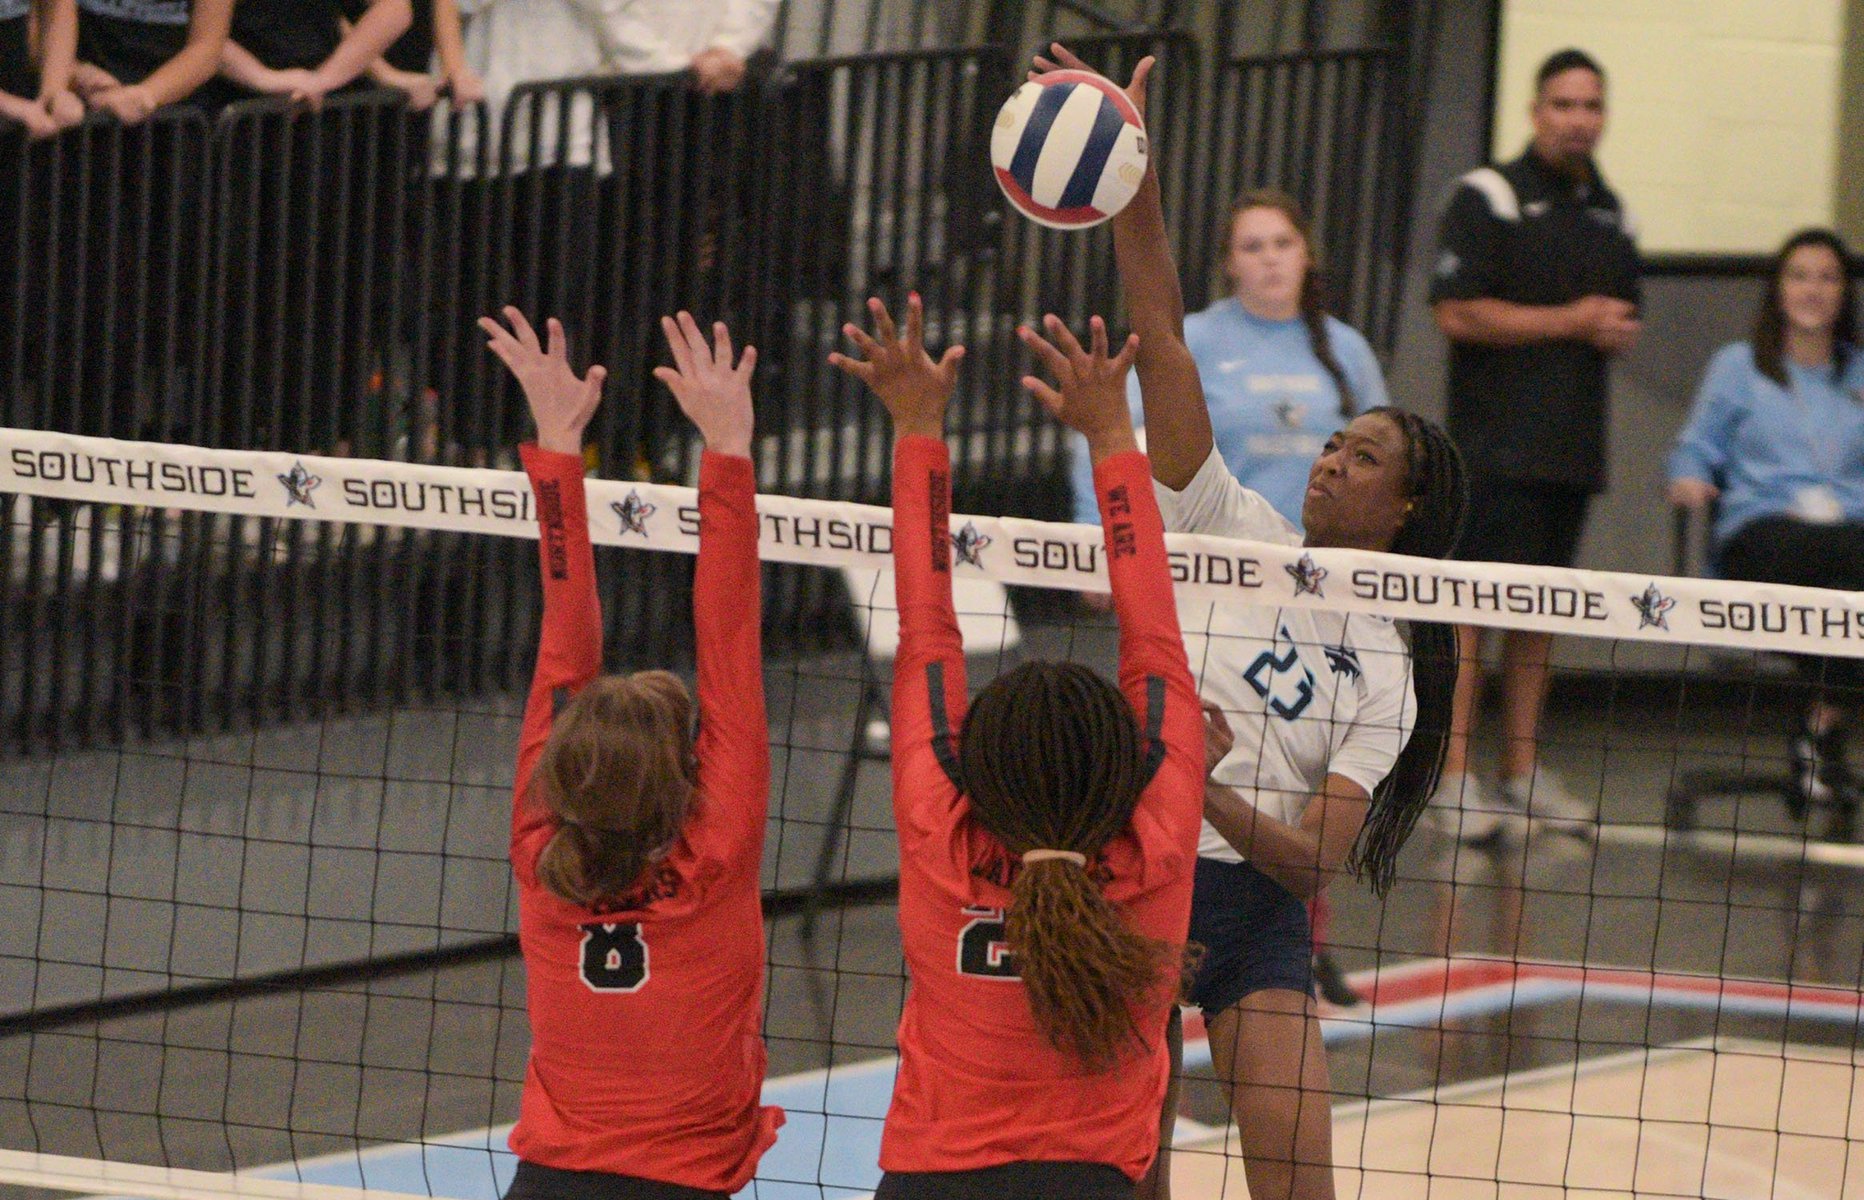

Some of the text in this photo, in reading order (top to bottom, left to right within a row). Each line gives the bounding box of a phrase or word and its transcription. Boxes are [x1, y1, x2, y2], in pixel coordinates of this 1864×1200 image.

[11, 448, 256, 499] SOUTHSIDE
[342, 477, 538, 521] SOUTHSI
[678, 505, 894, 554] STHSID
[1013, 536, 1264, 589] SOUSIDE
[1352, 568, 1610, 621] SOUTHSIDE
[1242, 624, 1316, 722] 23
